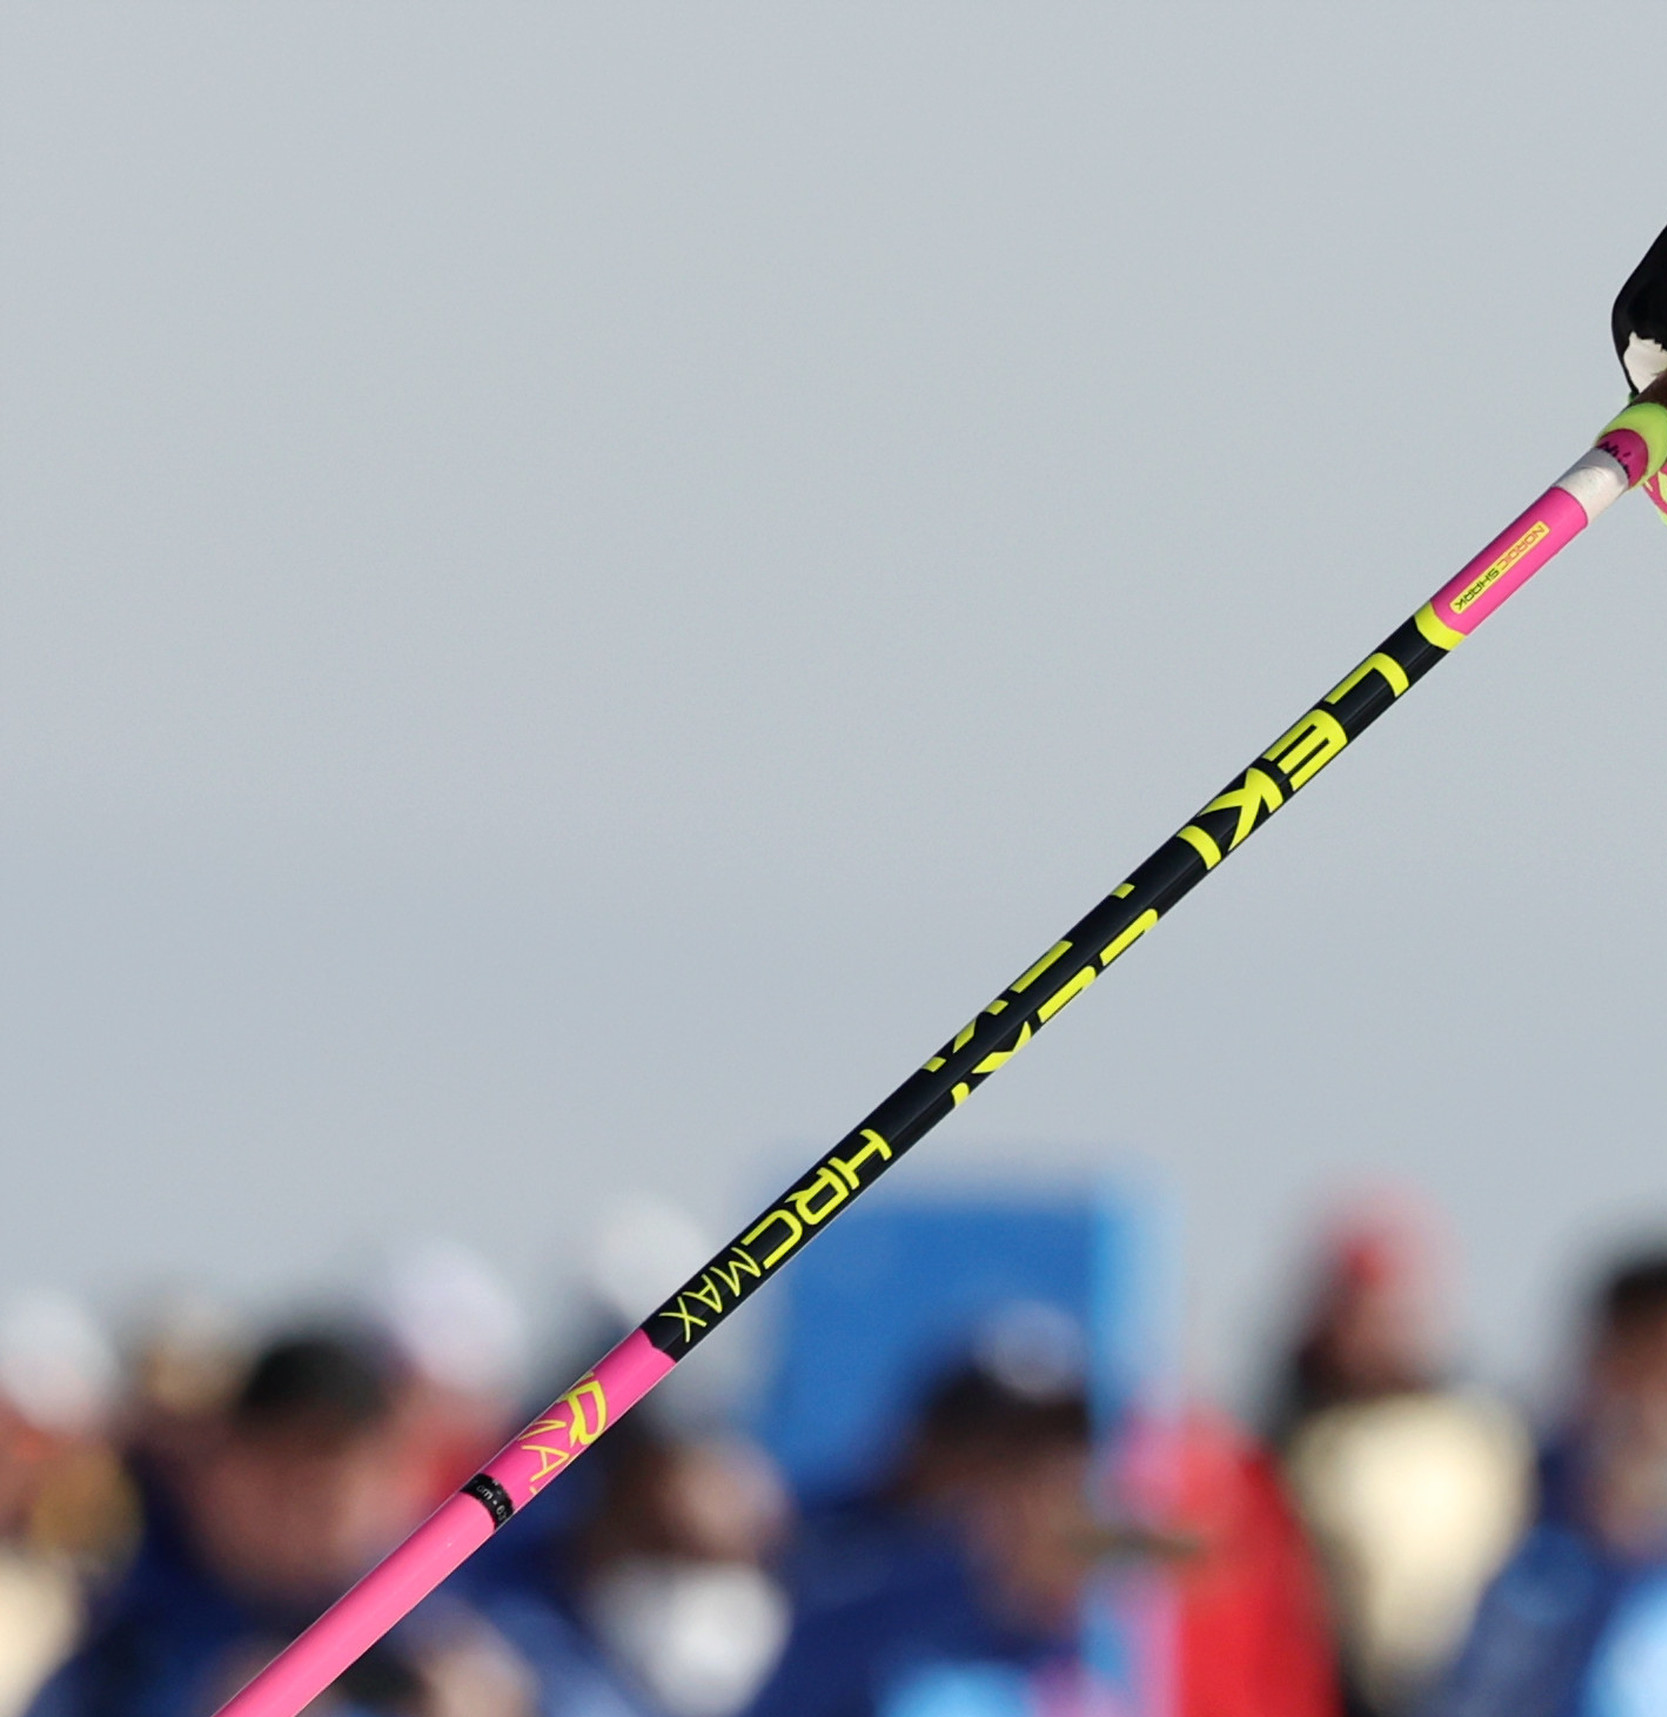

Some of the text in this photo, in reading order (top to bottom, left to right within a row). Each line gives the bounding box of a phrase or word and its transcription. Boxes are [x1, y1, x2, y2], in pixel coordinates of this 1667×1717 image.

[1453, 523, 1547, 611] NORDIC SHARK
[1176, 652, 1410, 870] LEKI
